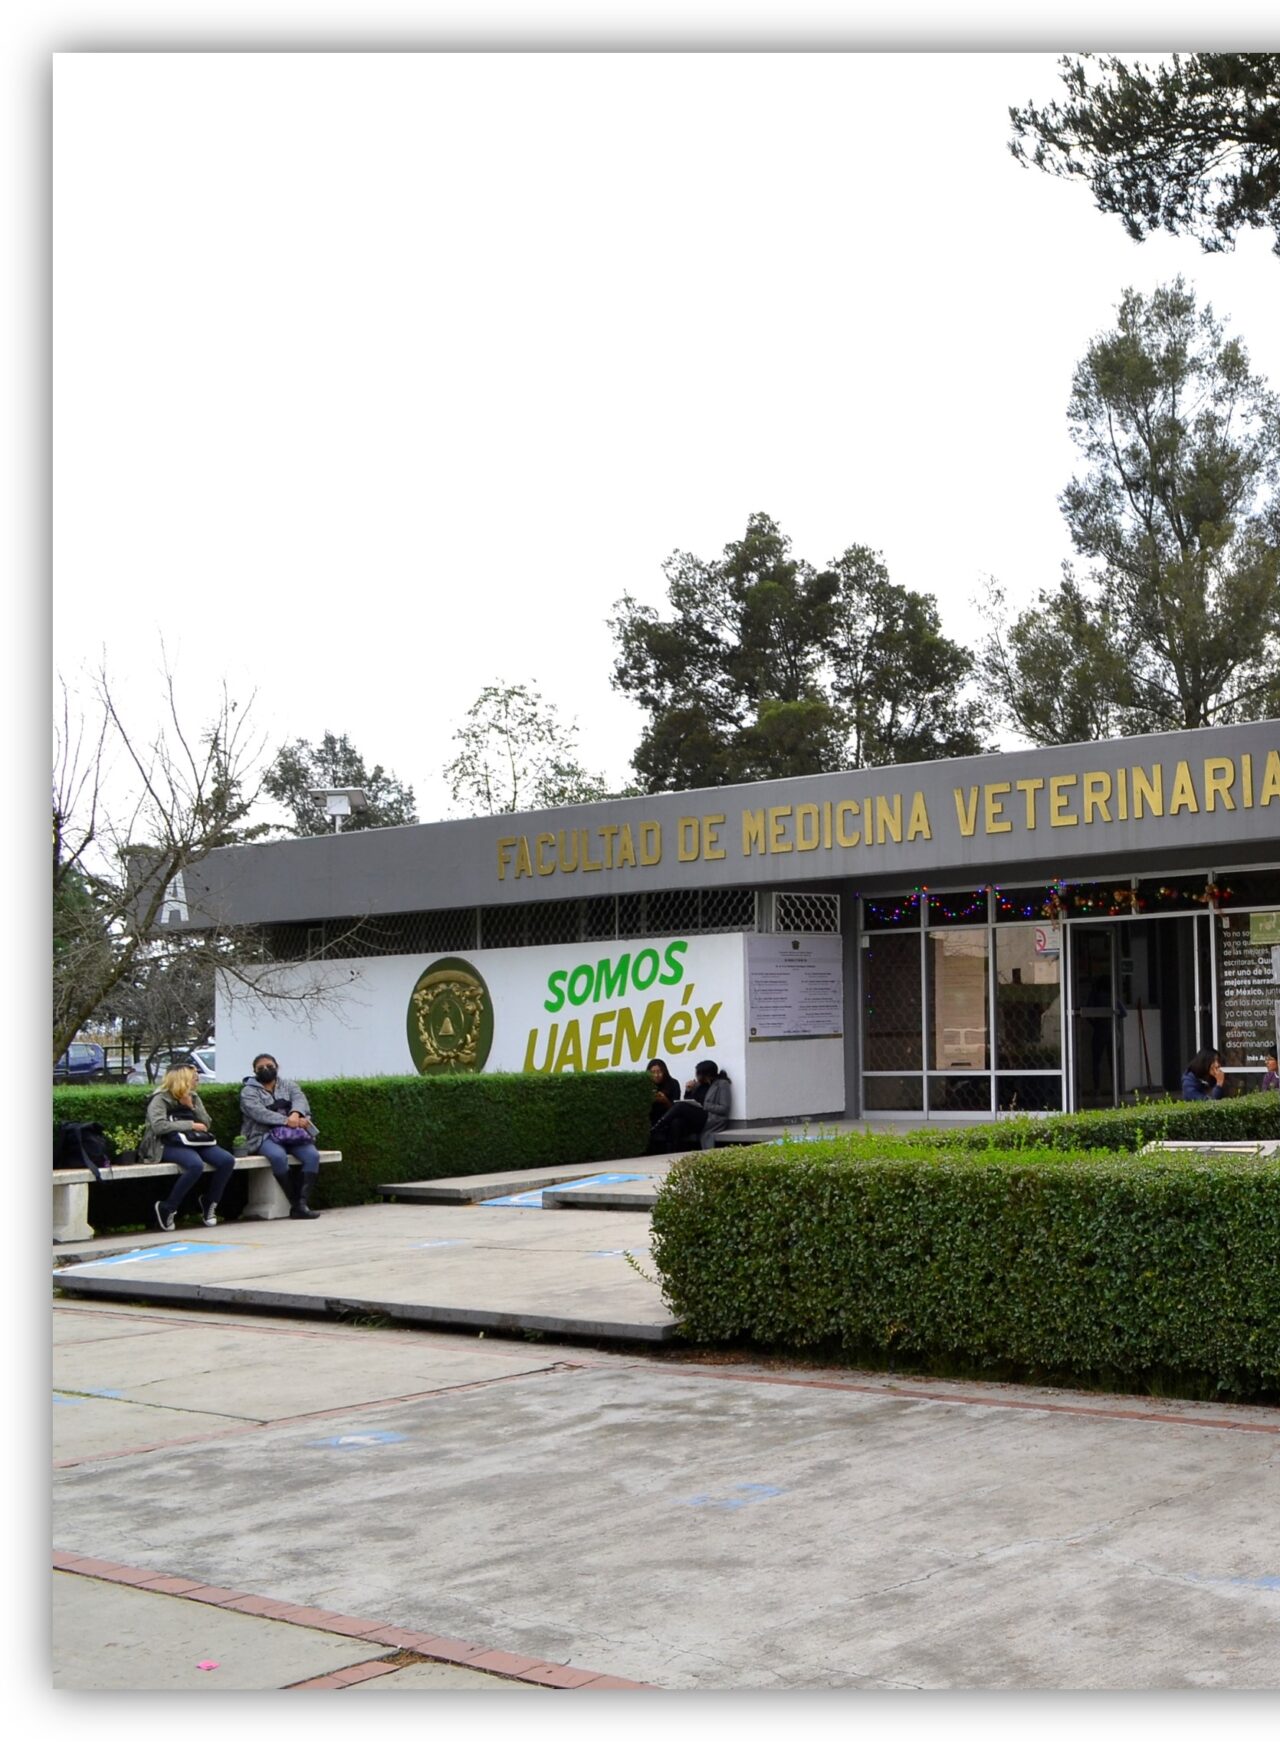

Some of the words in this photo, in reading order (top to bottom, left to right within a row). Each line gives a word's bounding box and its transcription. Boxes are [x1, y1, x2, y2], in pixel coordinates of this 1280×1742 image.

[497, 820, 662, 880] FACULTAD
[678, 814, 726, 862] DE
[742, 791, 932, 856] MEDICINA
[1258, 957, 1273, 966] Qui
[1253, 967, 1263, 976] de
[544, 940, 688, 1013] SOMOS
[1224, 978, 1252, 987] mejores
[1252, 978, 1275, 986] narrad
[1251, 998, 1274, 1006] hombr
[1225, 1011, 1234, 1019] yo
[1253, 1010, 1268, 1019] que
[523, 983, 723, 1073] UAEMéx
[1225, 1020, 1253, 1029] mujeres
[1254, 1019, 1268, 1027] nos
[1226, 1030, 1256, 1038] estamos
[1226, 1040, 1275, 1048] discriminando
